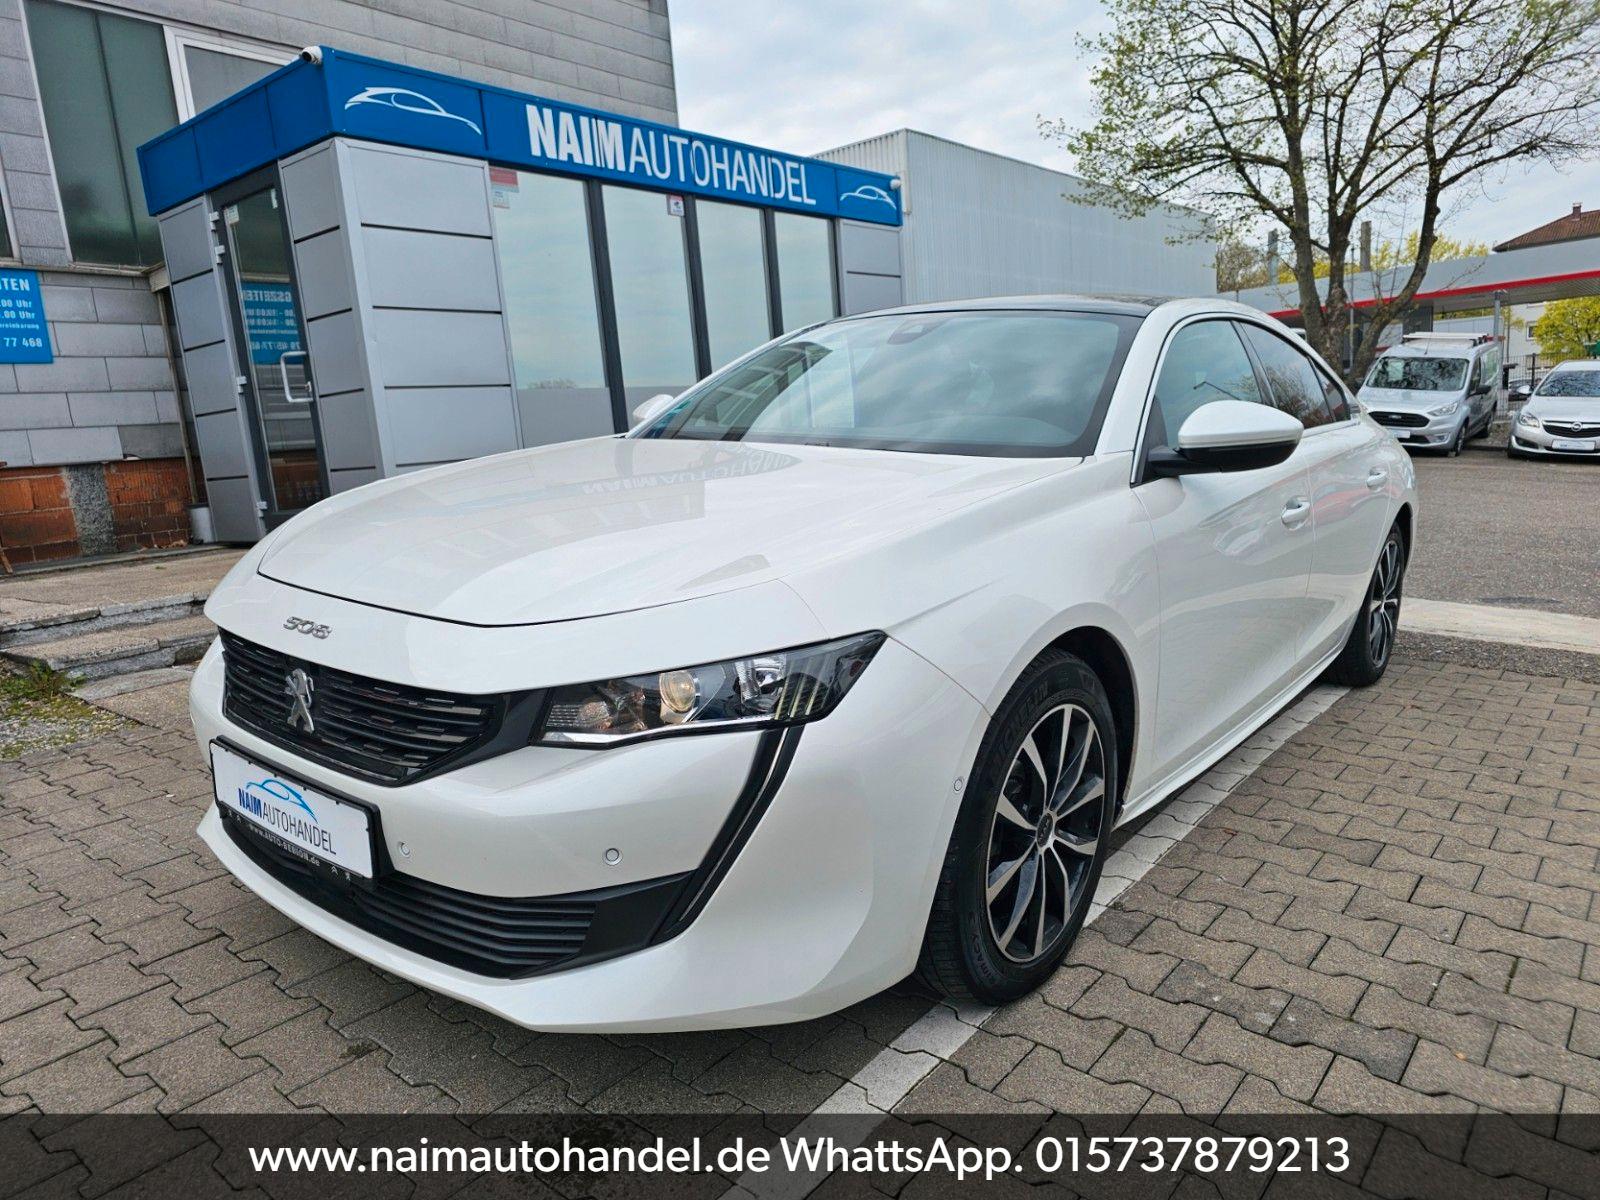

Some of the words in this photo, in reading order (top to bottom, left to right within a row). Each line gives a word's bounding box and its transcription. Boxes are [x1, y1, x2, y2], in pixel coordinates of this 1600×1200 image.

[0, 277, 30, 291] TEN
[16, 299, 32, 308] Uhr
[19, 310, 35, 319] Uhr
[283, 616, 332, 640] 508
